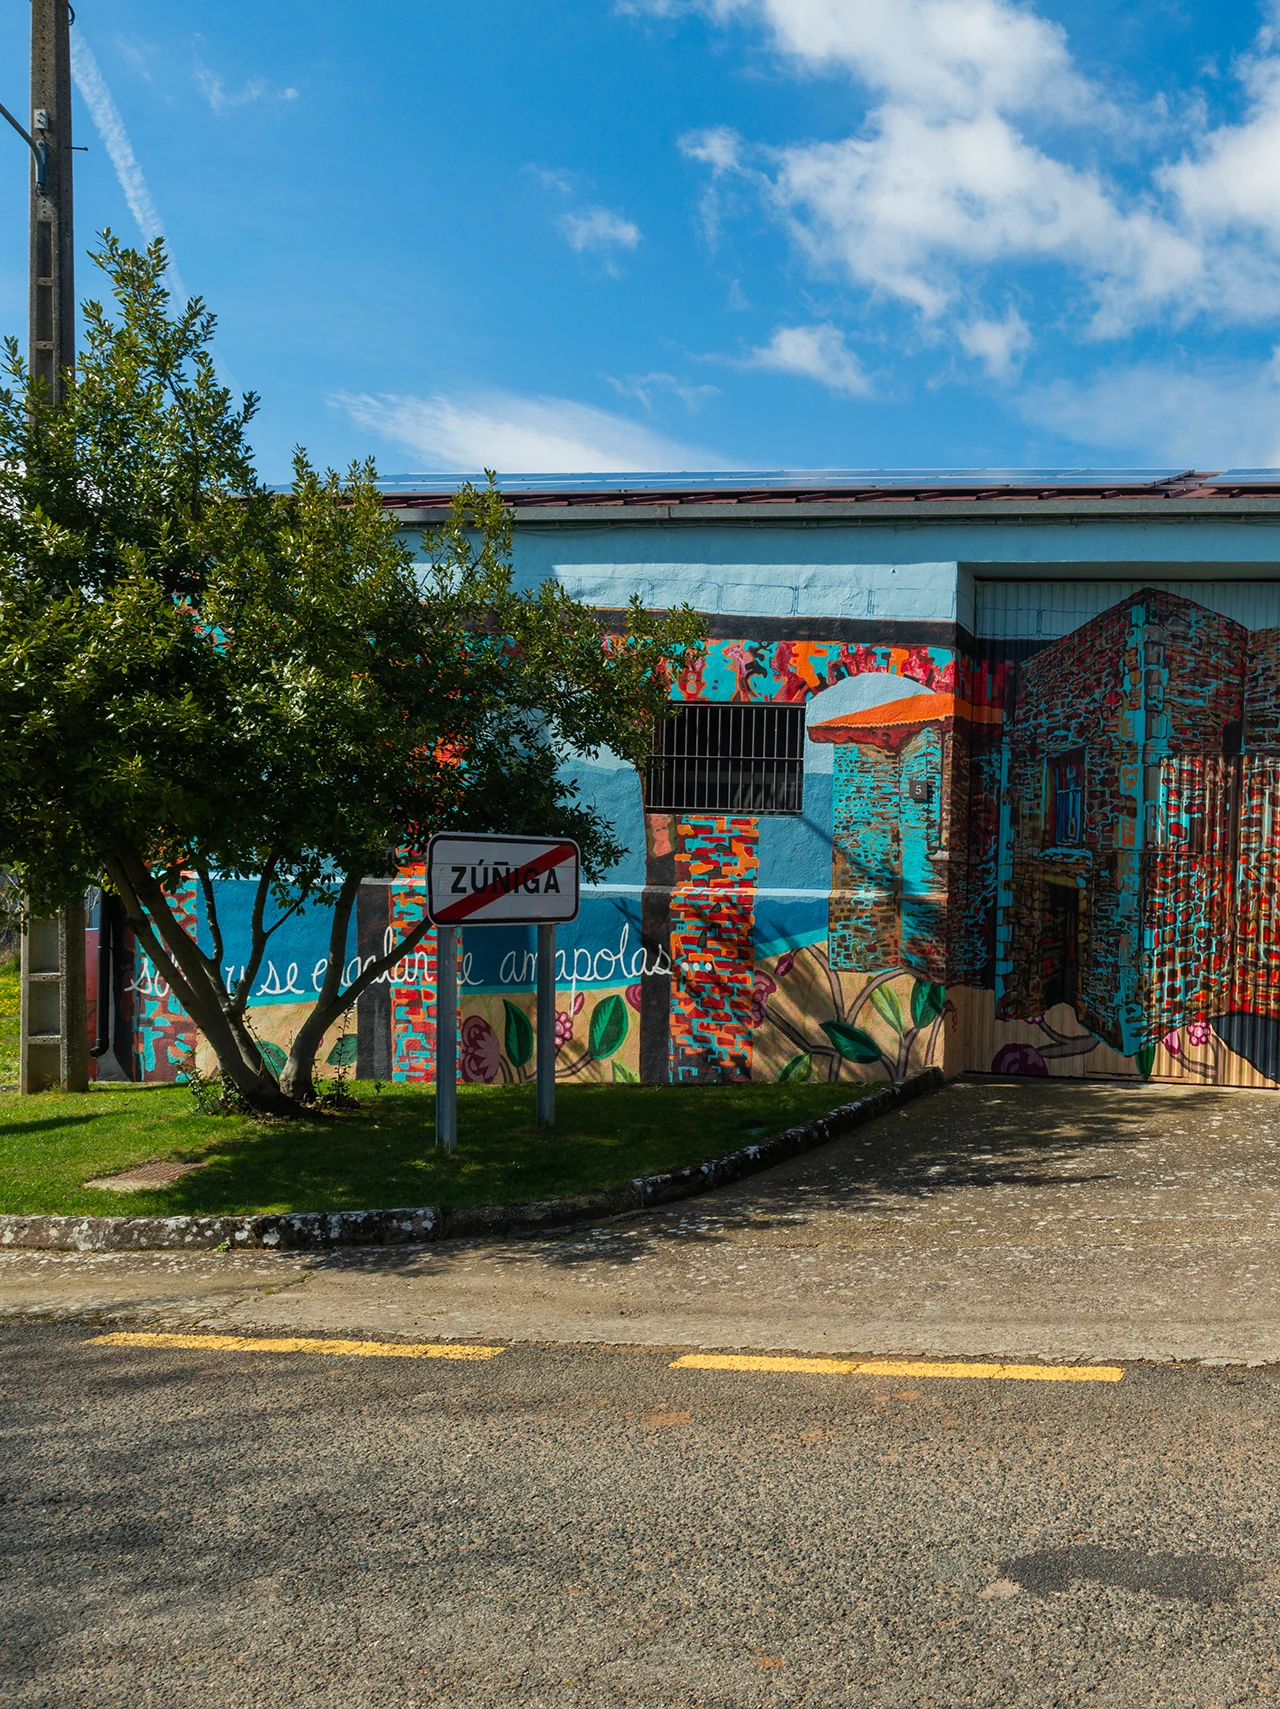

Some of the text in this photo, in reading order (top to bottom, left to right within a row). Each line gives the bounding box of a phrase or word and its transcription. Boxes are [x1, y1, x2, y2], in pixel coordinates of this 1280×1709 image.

[915, 784, 922, 795] 5
[451, 859, 561, 895] ZÚÑIGA
[255, 960, 305, 996] se
